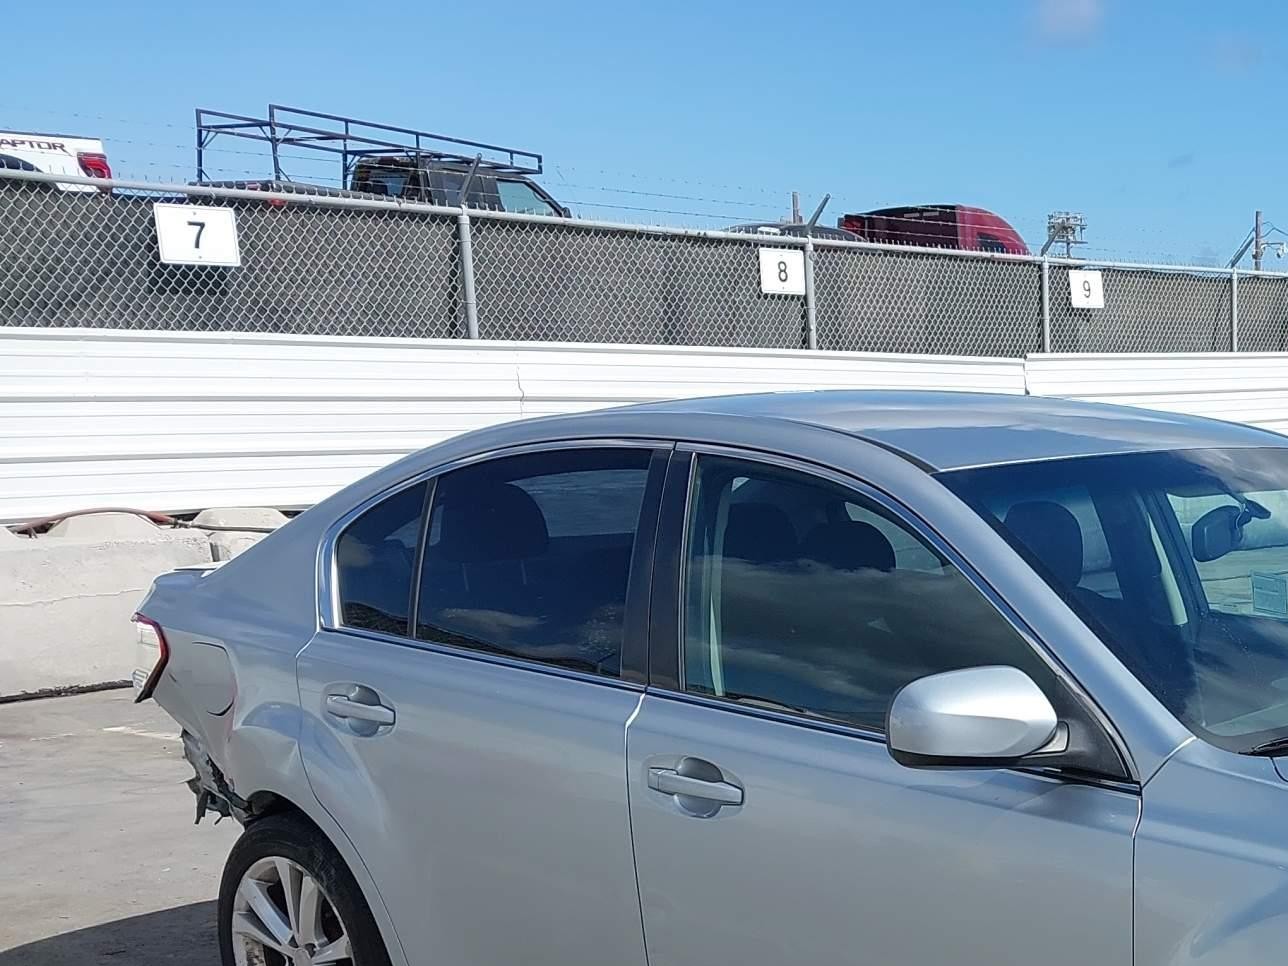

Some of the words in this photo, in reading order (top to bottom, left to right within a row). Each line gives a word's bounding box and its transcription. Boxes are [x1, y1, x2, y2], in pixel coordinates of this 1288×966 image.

[188, 221, 206, 249] 7
[777, 261, 788, 283] 8
[1083, 280, 1092, 298] 9
